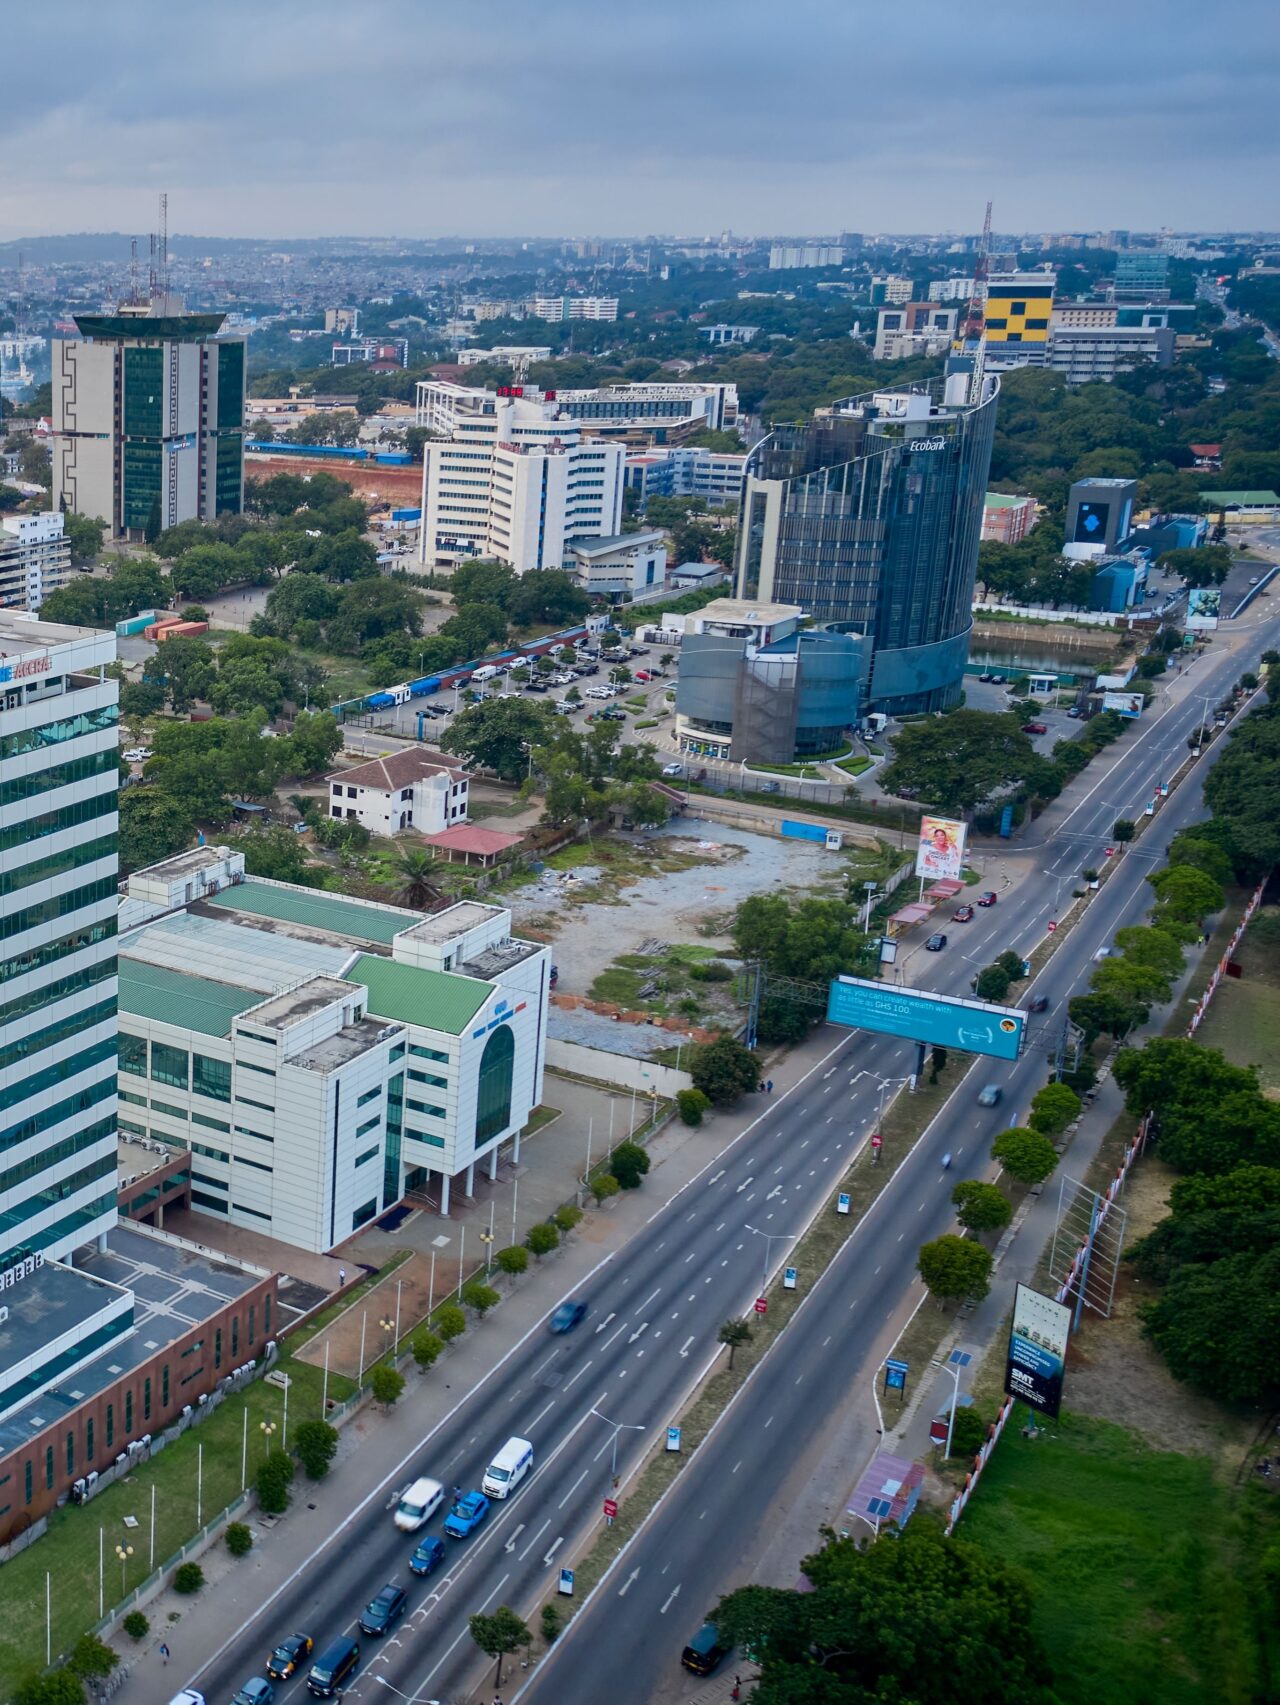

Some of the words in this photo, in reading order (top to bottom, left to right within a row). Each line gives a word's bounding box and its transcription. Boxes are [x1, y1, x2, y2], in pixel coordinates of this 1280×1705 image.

[910, 437, 946, 451] Ecobank
[14, 656, 50, 680] ACCRA
[847, 996, 864, 1005] little
[875, 1002, 891, 1011] GHS
[854, 989, 868, 999] you
[869, 992, 883, 1001] can
[884, 994, 908, 1006] create
[909, 1000, 934, 1010] wealth
[935, 1006, 952, 1015] with
[1014, 1350, 1030, 1362] POWER
[1015, 1340, 1041, 1356] EXPERIENCE
[1011, 1368, 1034, 1385] SMT
